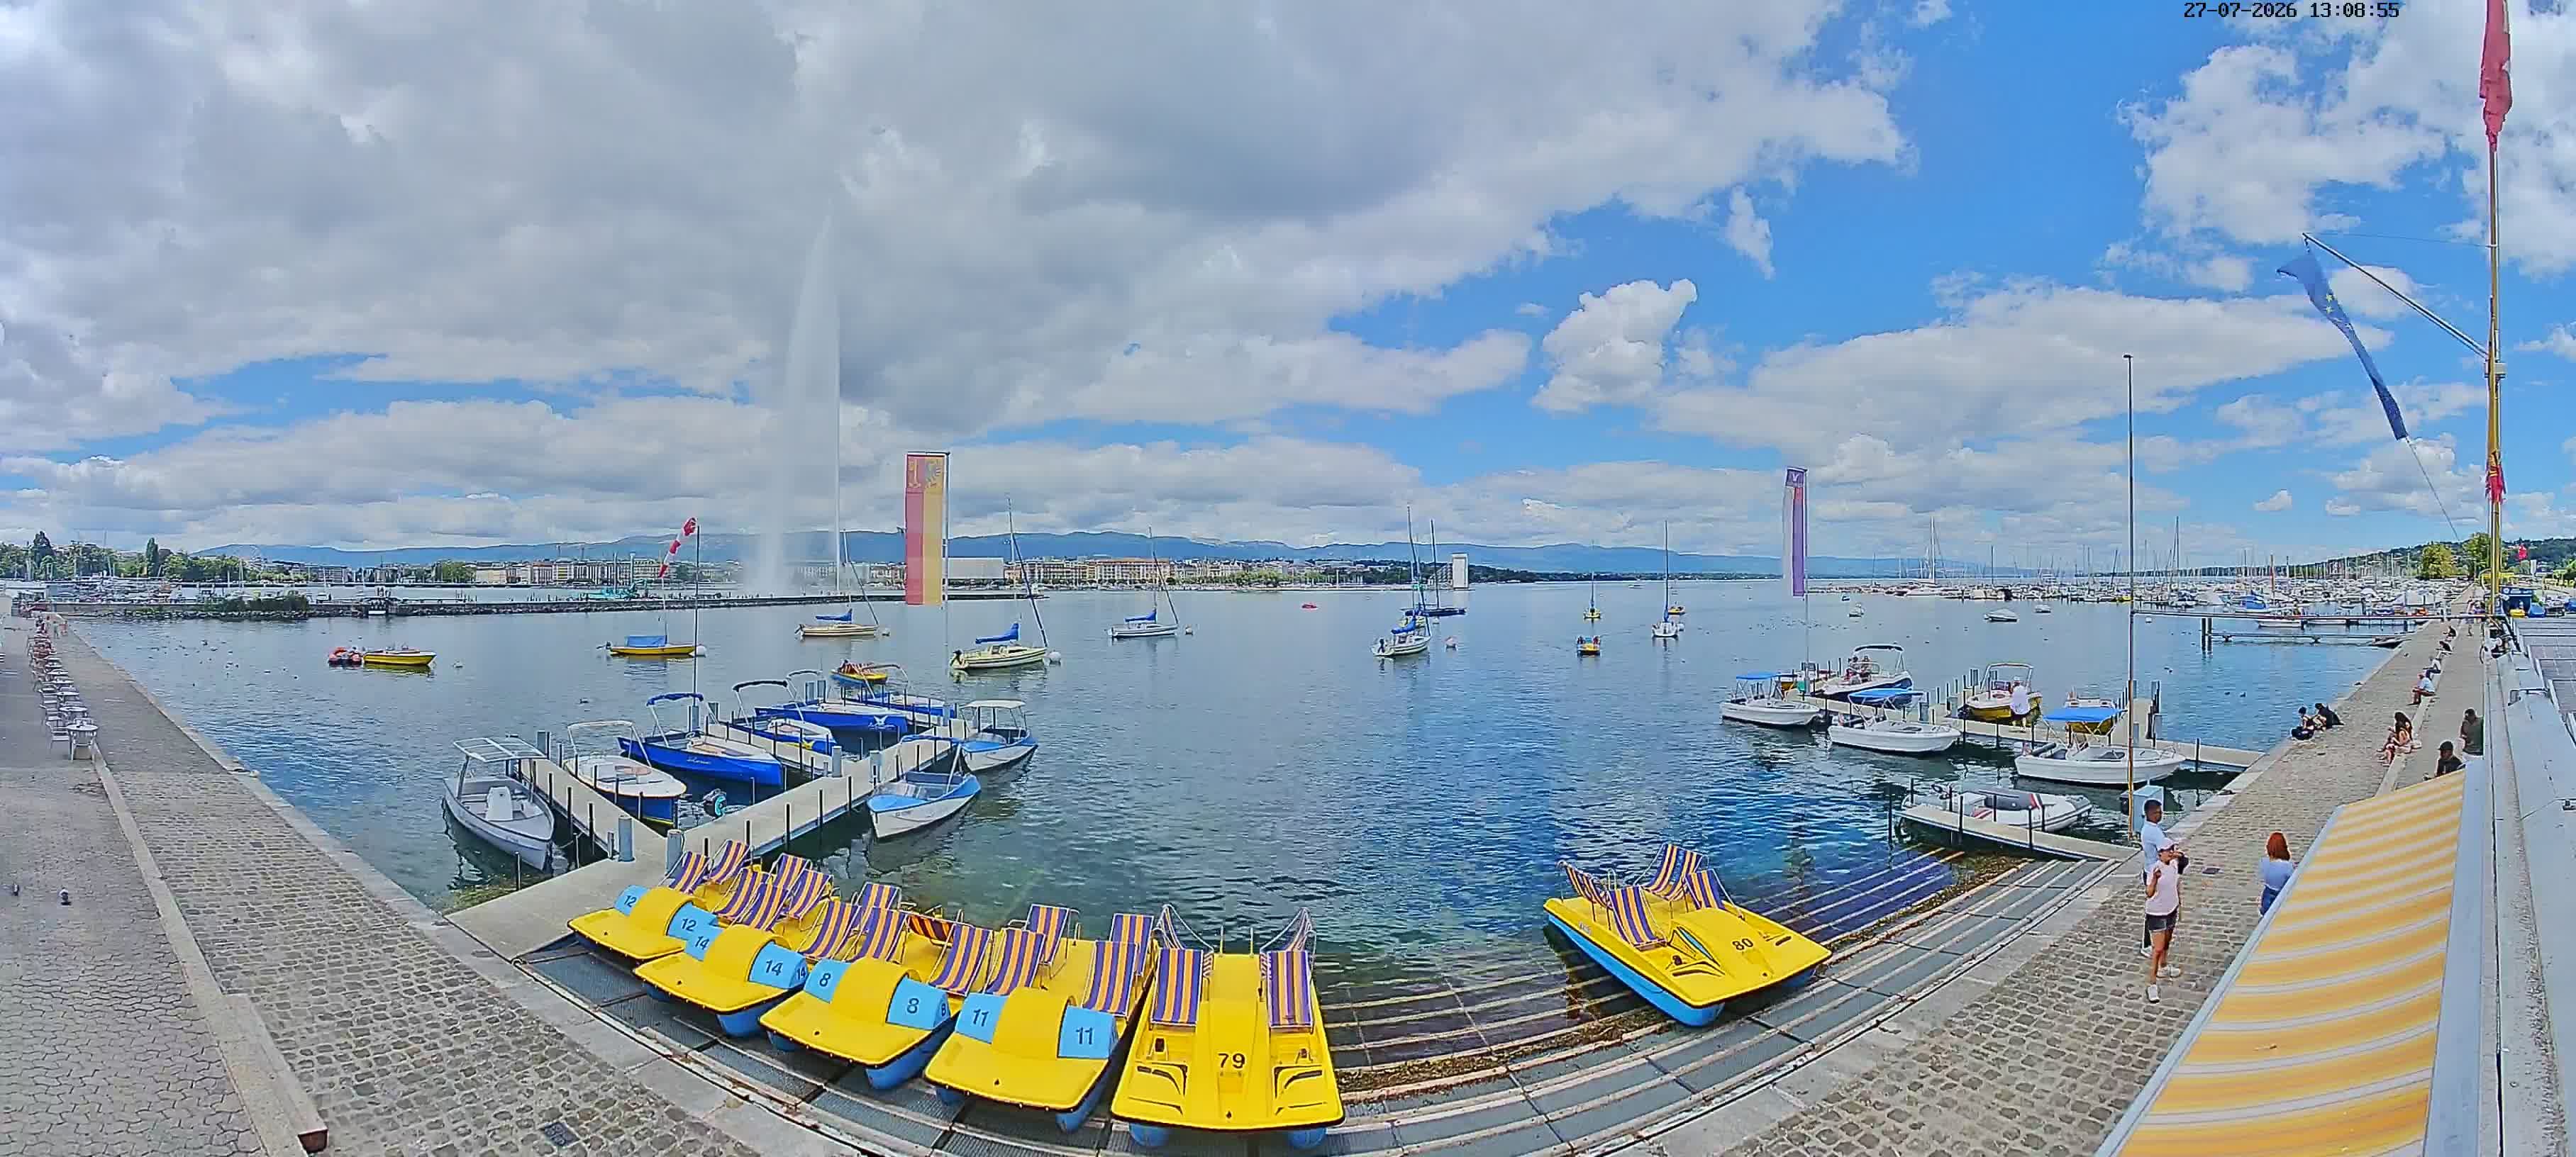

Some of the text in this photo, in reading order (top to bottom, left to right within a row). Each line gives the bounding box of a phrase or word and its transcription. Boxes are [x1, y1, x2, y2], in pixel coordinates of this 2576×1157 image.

[624, 895, 637, 907] 12
[681, 918, 696, 932] 12
[695, 936, 710, 951] 14
[1732, 938, 1753, 950] 80
[765, 959, 783, 976] 14
[796, 967, 806, 980] 14
[819, 973, 831, 987] 8
[906, 997, 920, 1014] 8
[973, 1009, 989, 1027] 11
[1075, 1027, 1093, 1045] 11
[1218, 1053, 1245, 1069] 79
